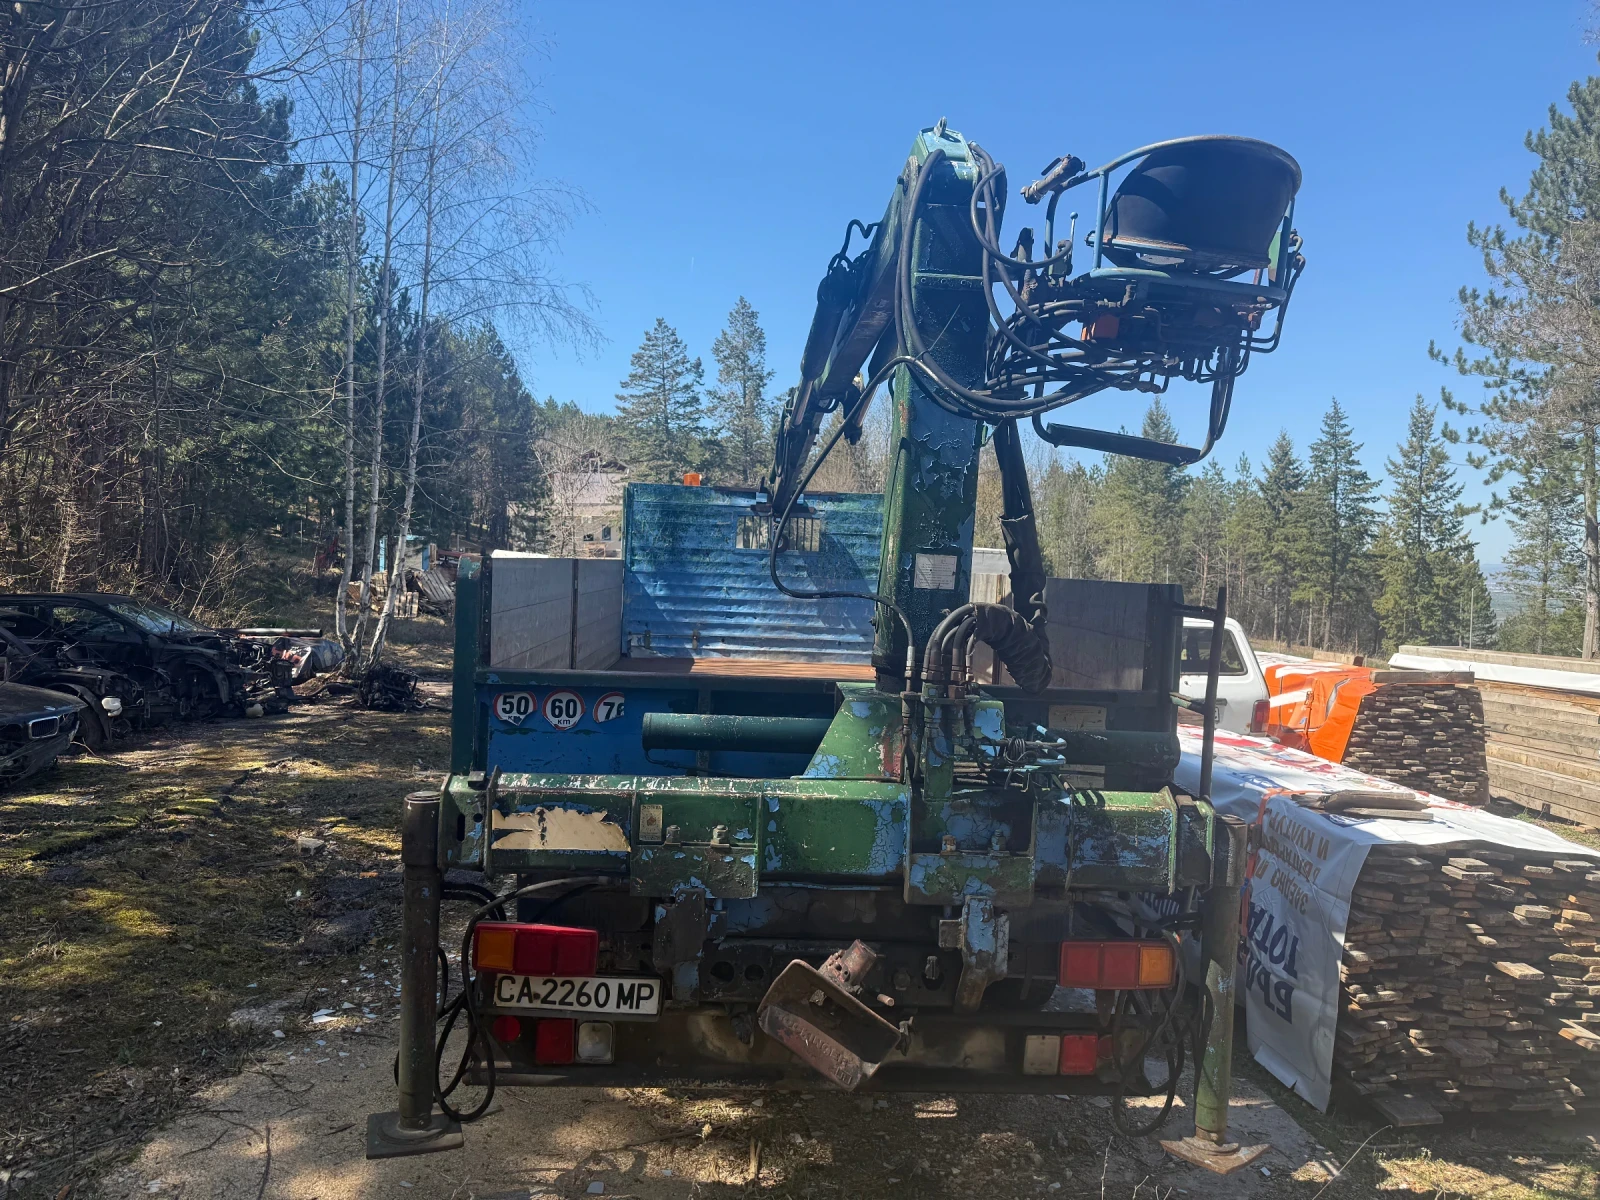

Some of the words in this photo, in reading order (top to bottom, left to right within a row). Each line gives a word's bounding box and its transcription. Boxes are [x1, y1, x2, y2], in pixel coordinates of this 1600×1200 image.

[501, 694, 529, 716] 50
[550, 698, 577, 719] 60
[496, 975, 533, 1004] CA
[540, 978, 611, 1008] 2260
[615, 982, 655, 1010] MP
